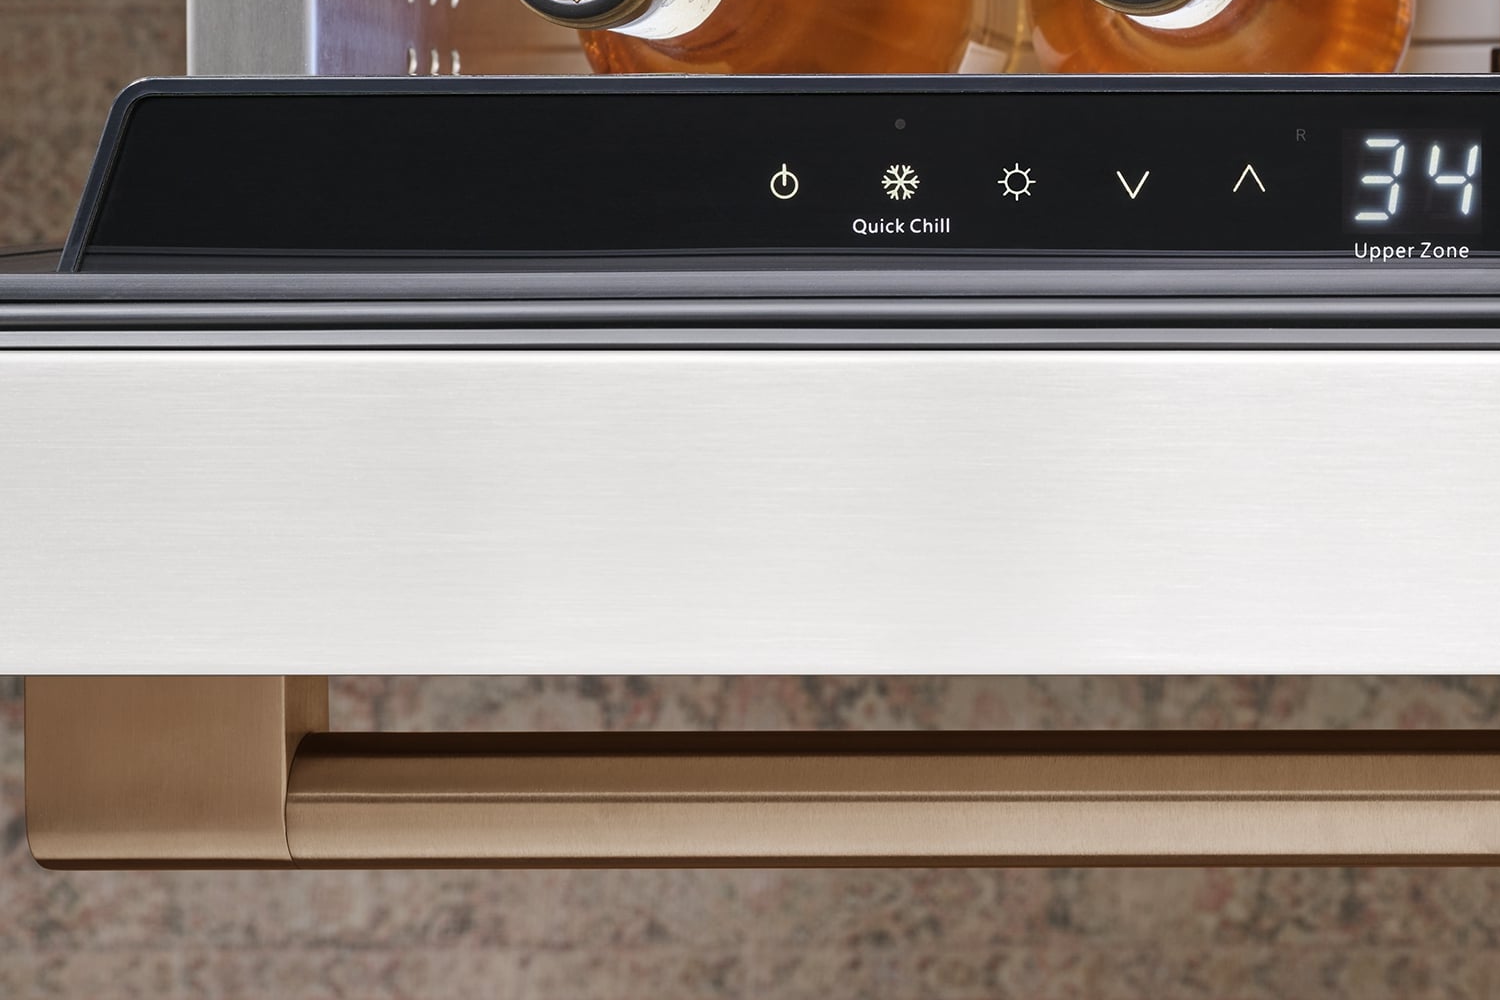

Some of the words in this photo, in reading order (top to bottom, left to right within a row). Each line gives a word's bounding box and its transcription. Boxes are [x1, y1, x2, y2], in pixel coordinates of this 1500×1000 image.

[1296, 128, 1306, 141] R
[1354, 137, 1481, 222] 34
[853, 217, 905, 236] Quick
[909, 217, 951, 234] Chill
[1354, 242, 1415, 262] Upper
[1420, 242, 1470, 259] Zone
